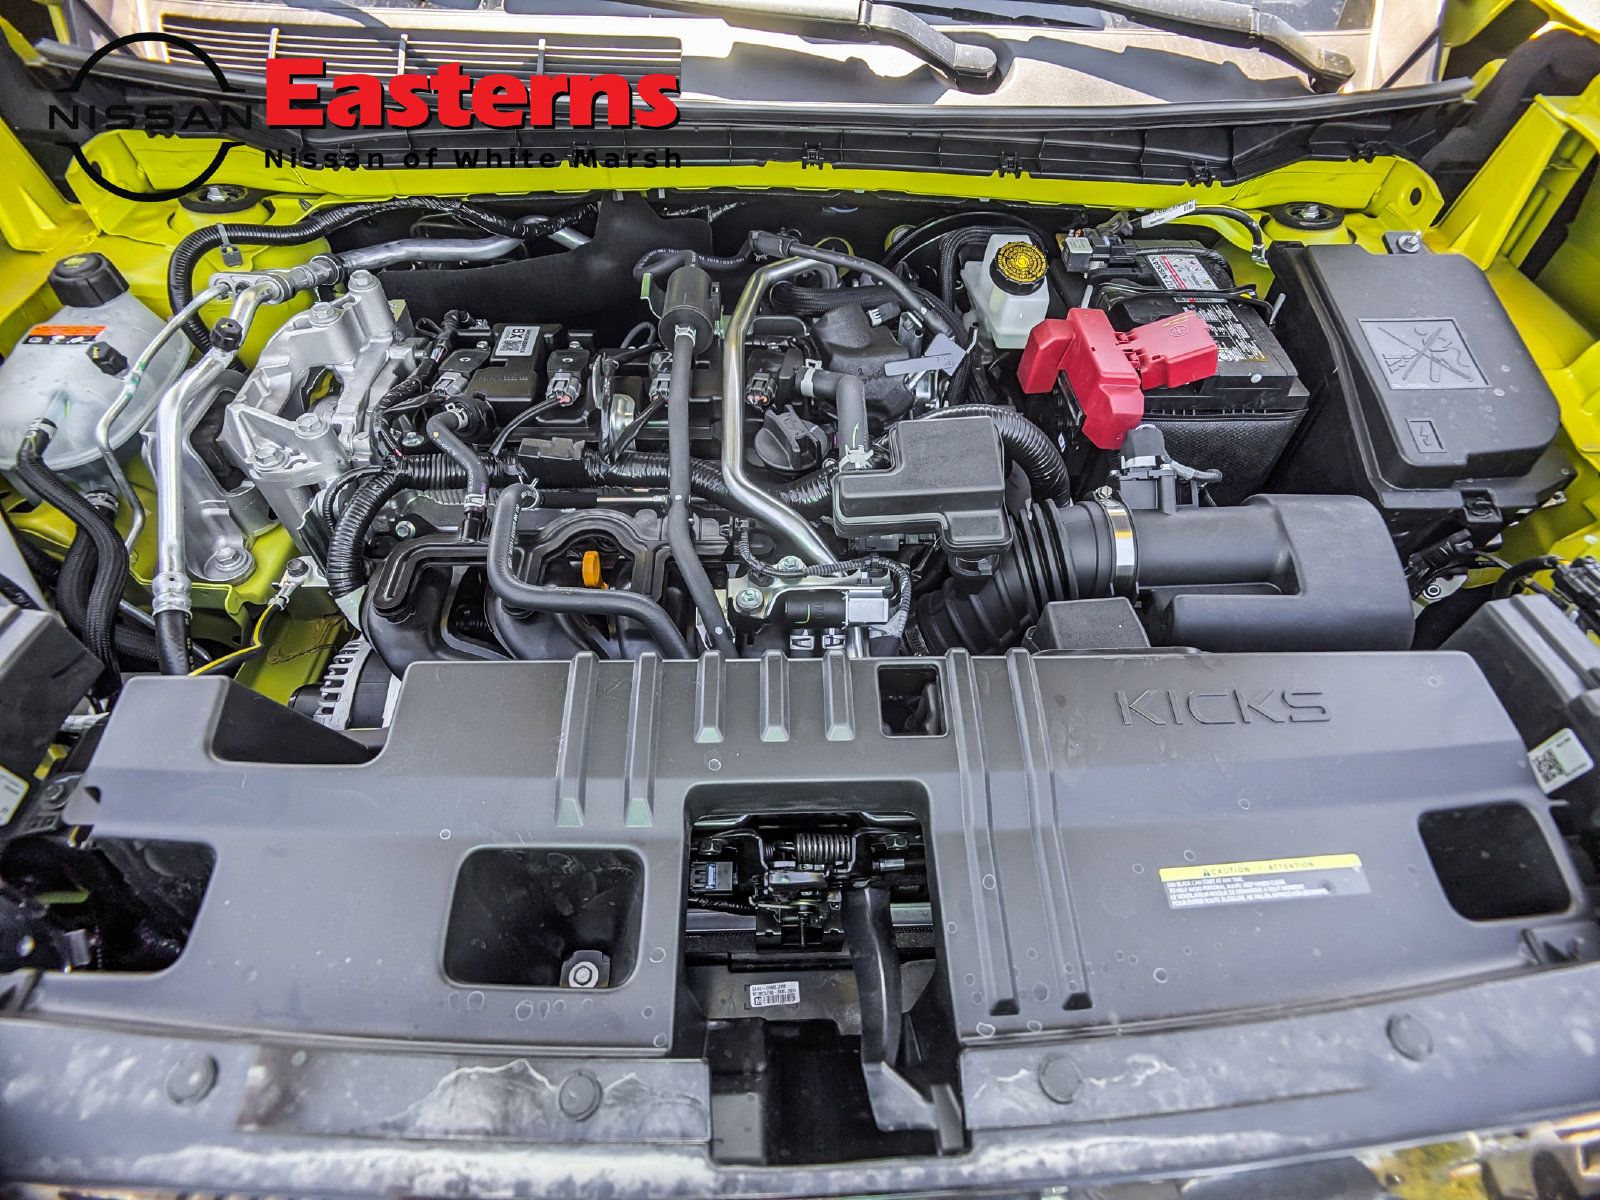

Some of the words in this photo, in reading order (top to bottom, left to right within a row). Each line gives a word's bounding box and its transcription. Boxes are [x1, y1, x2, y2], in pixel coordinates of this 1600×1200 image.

[510, 329, 525, 338] BX
[1115, 689, 1330, 725] KICKS
[1211, 867, 1250, 875] CAUTION
[1269, 861, 1315, 870] ATTENTION
